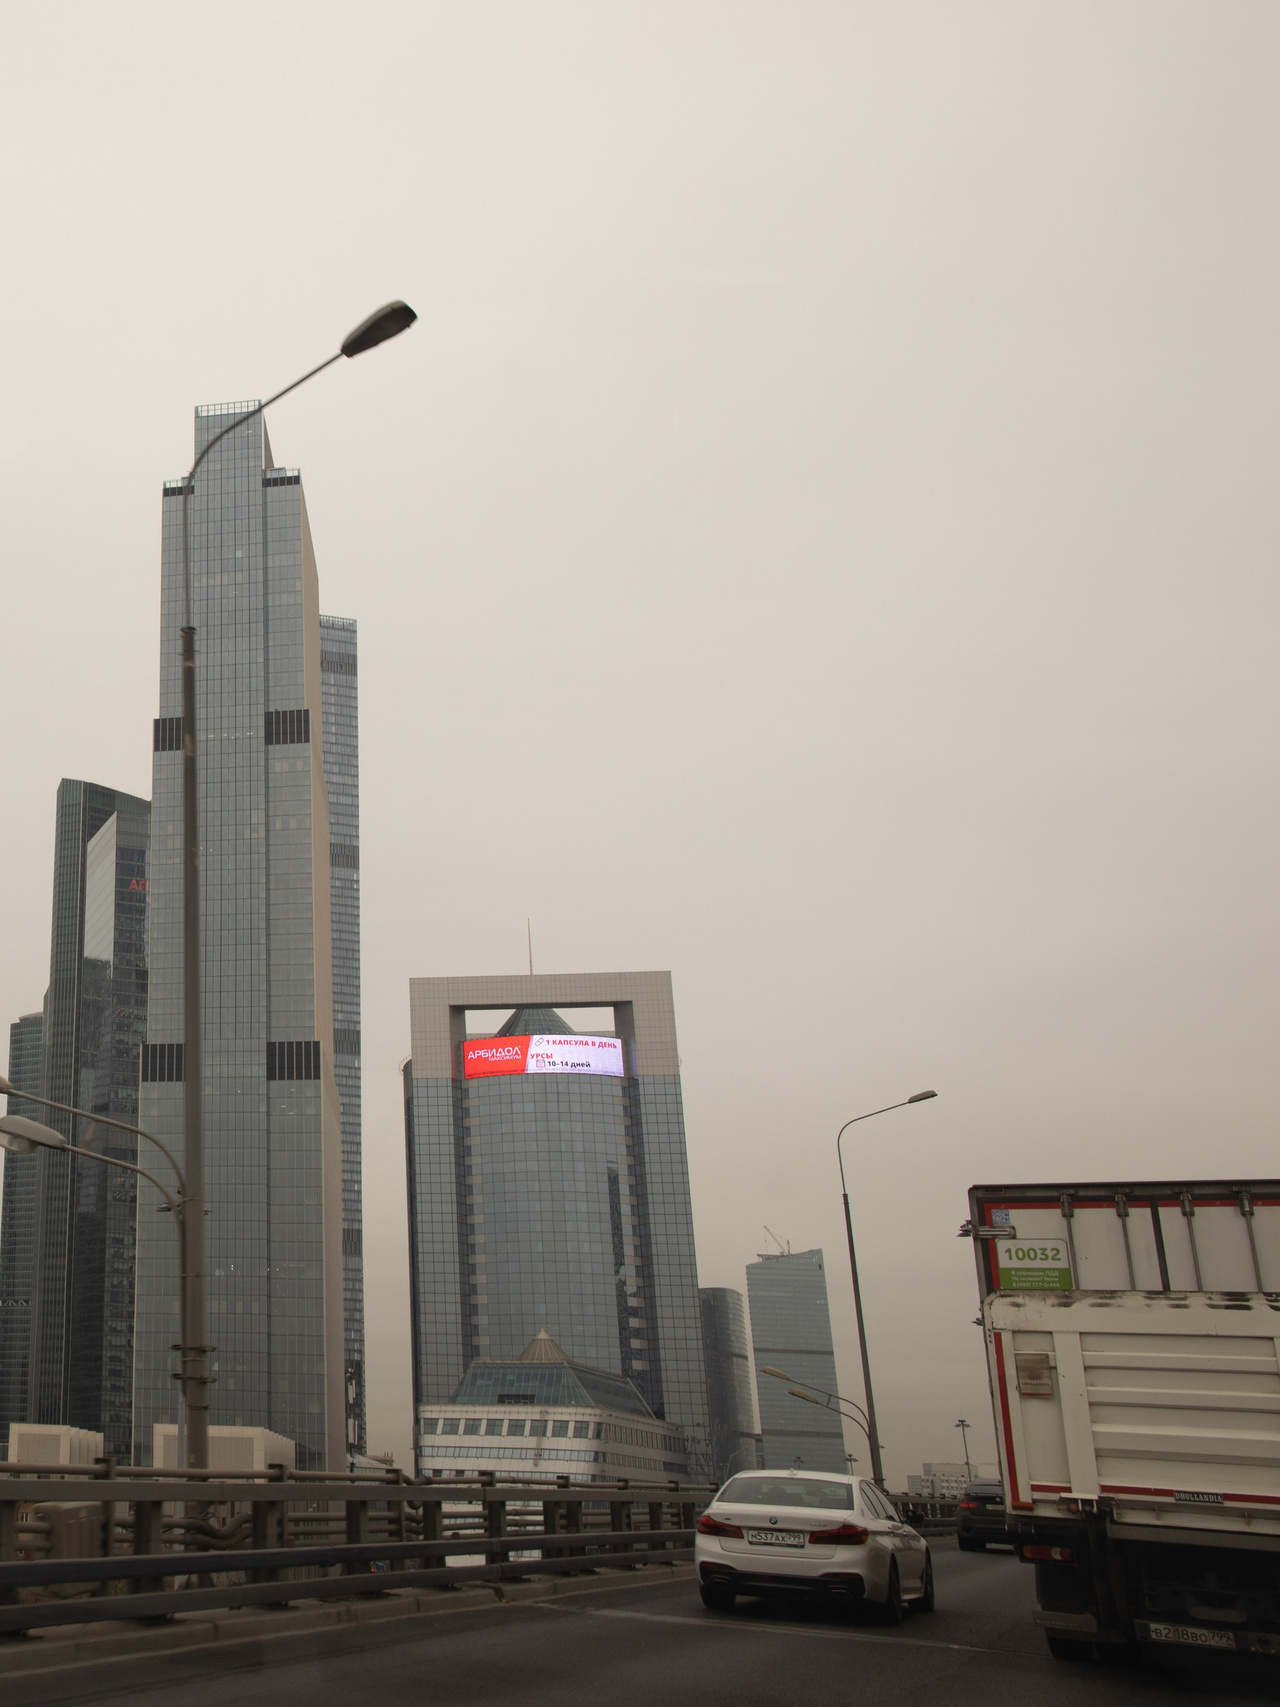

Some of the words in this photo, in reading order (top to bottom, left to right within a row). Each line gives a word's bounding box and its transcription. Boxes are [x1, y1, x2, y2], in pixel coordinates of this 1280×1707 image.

[552, 1039, 589, 1047] КАПСУЛА
[467, 1046, 521, 1060] АРБИДОЛ
[488, 1054, 521, 1062] МАКСИМУМ
[570, 1061, 591, 1069] дней
[1004, 1247, 1062, 1262] 10032
[1175, 1492, 1223, 1503] DHOLLANDIA
[1210, 1630, 1230, 1642] 799
